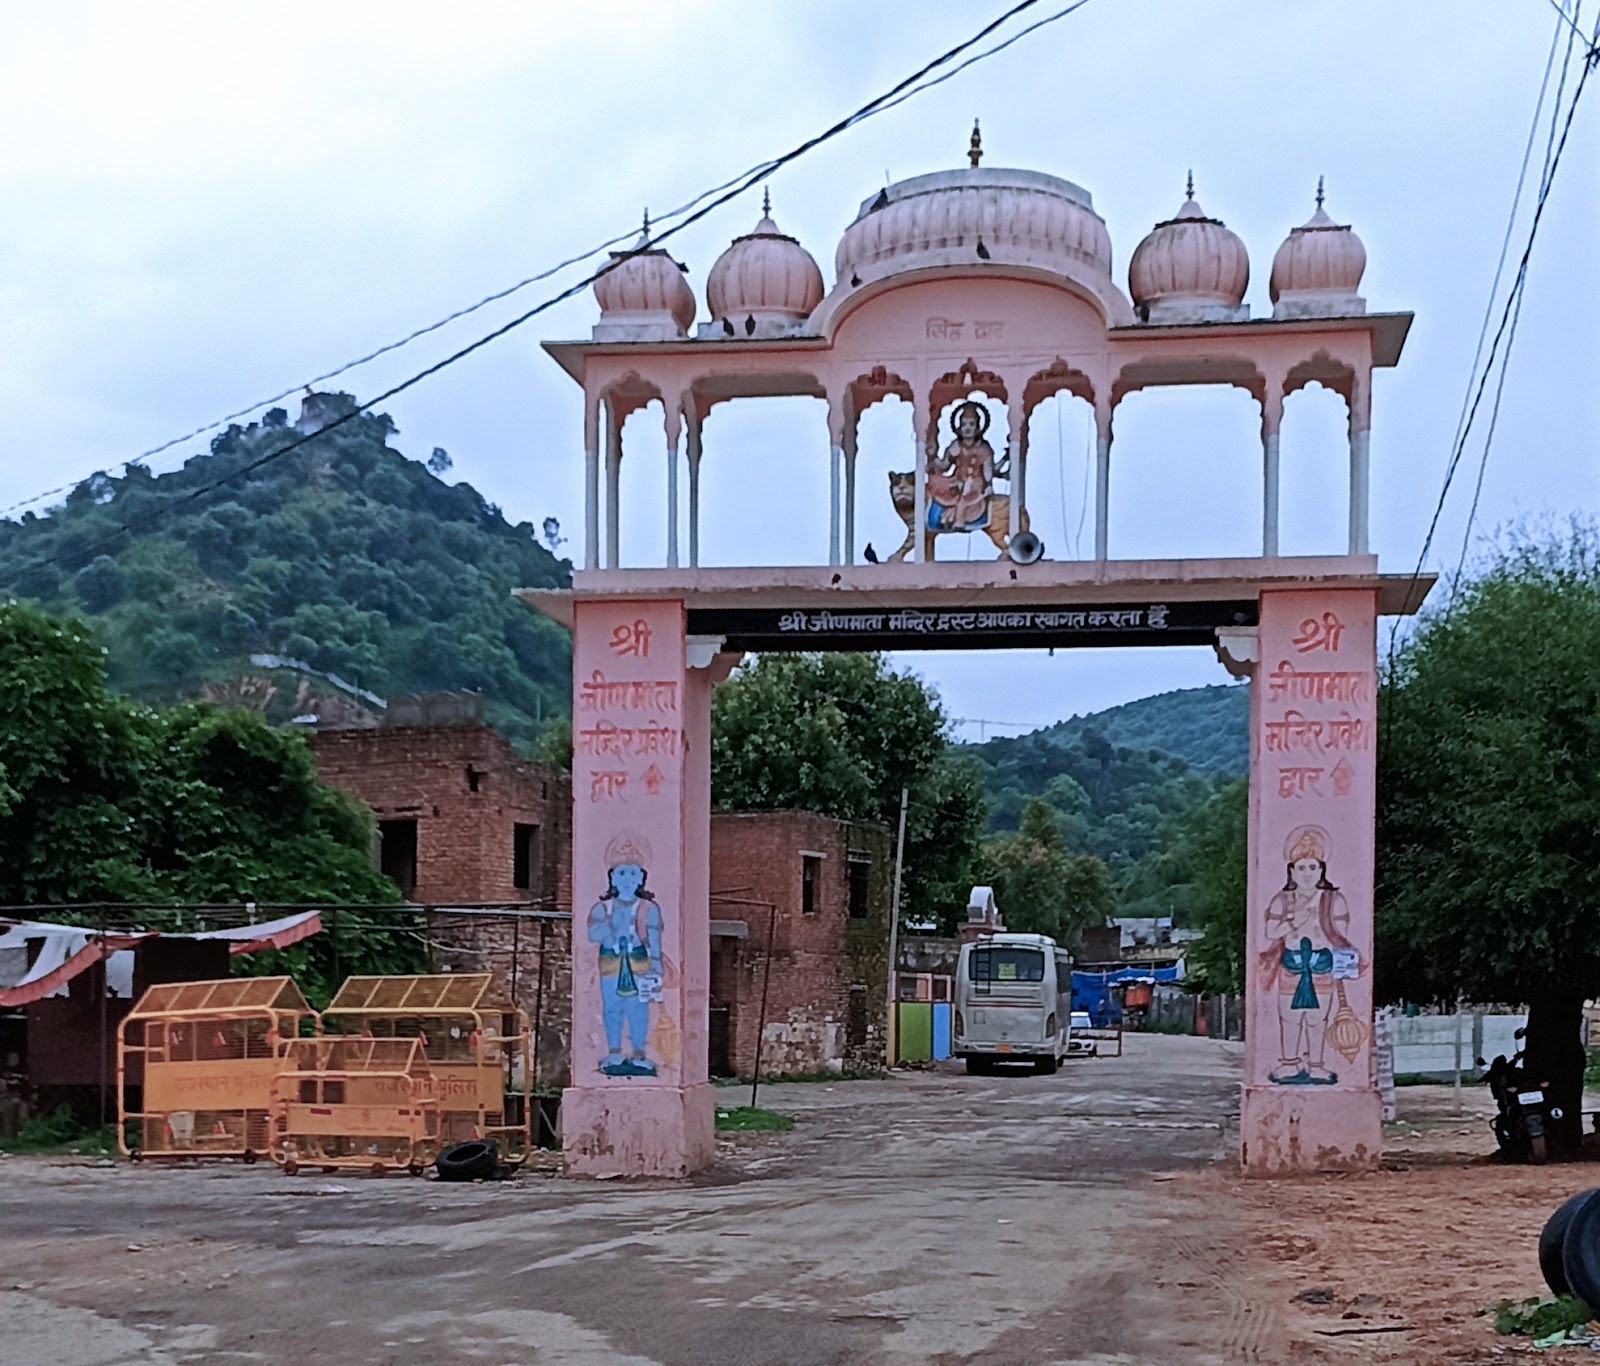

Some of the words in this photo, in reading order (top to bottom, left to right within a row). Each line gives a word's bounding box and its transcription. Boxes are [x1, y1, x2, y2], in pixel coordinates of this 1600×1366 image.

[609, 619, 652, 657] श्री
[778, 610, 808, 631] श्री
[888, 609, 937, 634] मन्दिर
[976, 612, 1034, 629] आपका
[1034, 611, 1087, 631] स्वागत
[1088, 610, 1143, 628] करता
[1292, 611, 1345, 652] श्री
[590, 769, 628, 805] द्वार
[1277, 766, 1325, 799] द्वार
